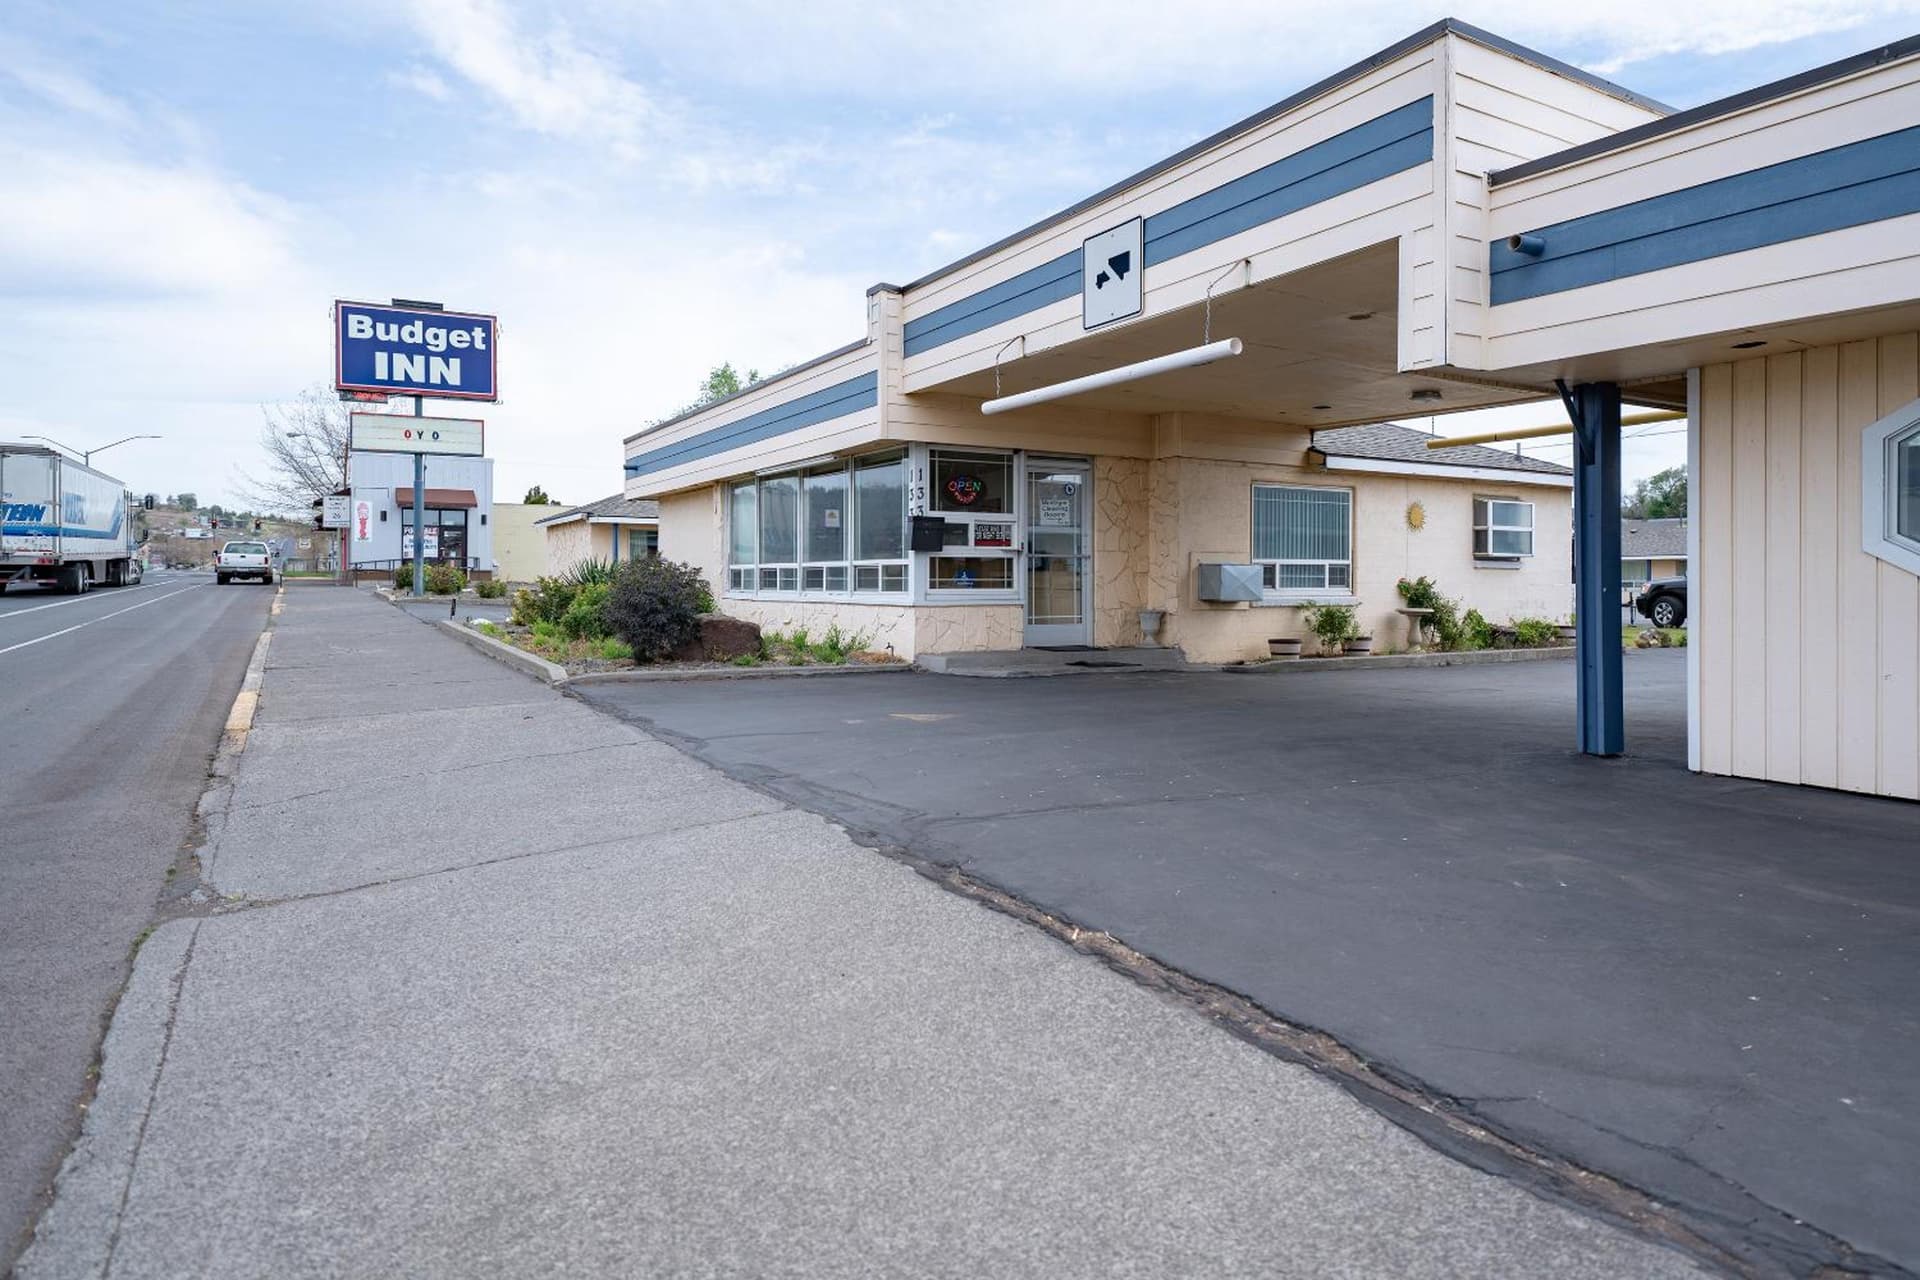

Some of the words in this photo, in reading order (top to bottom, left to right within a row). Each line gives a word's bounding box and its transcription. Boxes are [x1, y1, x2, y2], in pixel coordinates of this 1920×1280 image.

[348, 314, 487, 352] Budget
[375, 351, 461, 386] INN
[948, 481, 982, 492] OPEN
